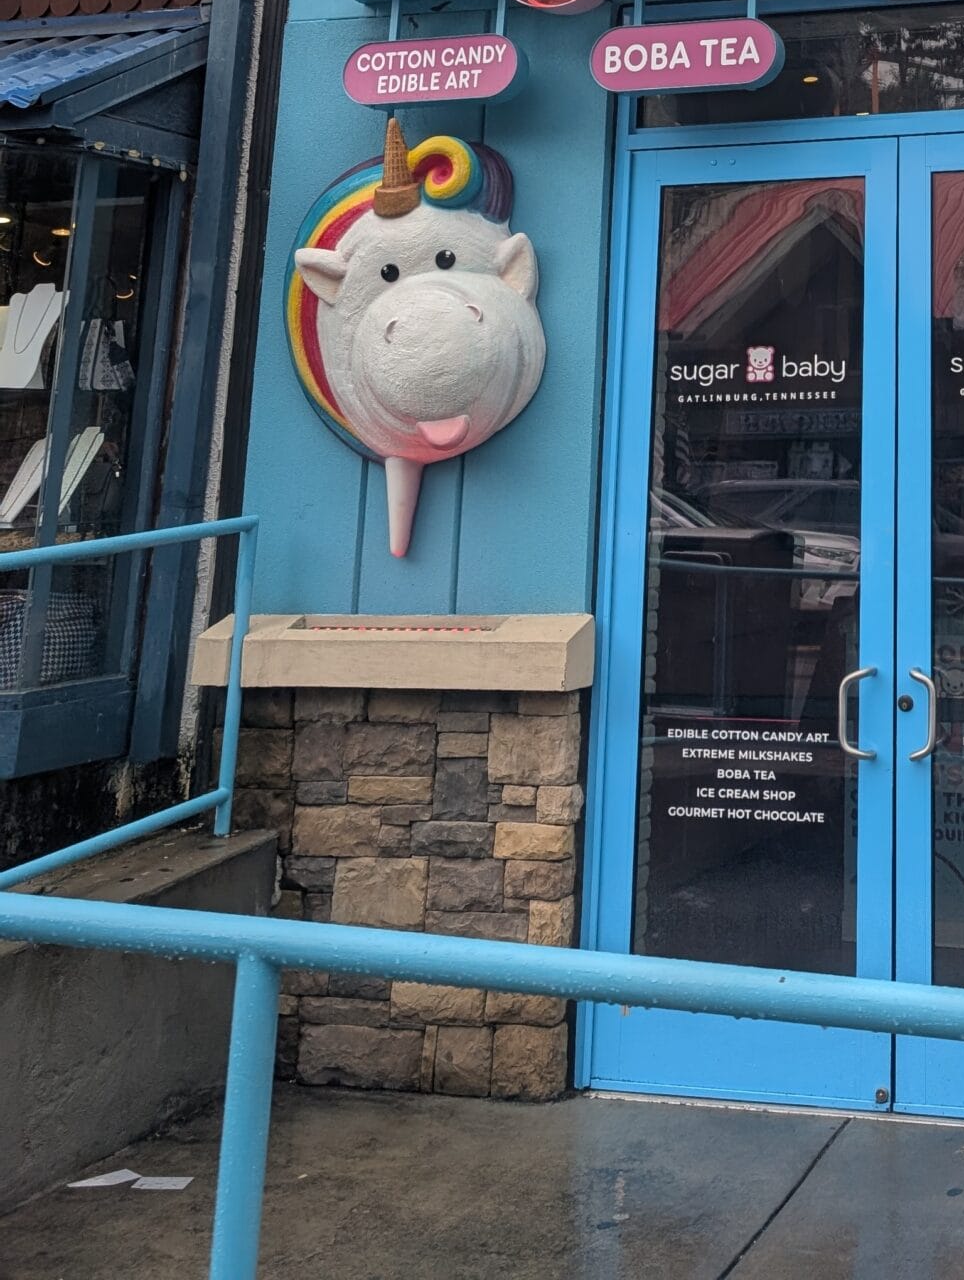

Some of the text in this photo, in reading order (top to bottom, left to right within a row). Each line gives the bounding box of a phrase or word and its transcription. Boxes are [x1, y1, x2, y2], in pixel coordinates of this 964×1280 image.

[356, 43, 507, 73] COTTON CANDY
[604, 36, 760, 74] BOBA TEA
[377, 69, 483, 94] EDIBLE ART
[670, 353, 846, 387] sugar baby
[667, 729, 830, 743] EDIBLE COTTON CANDY ART
[682, 748, 813, 762] EXTREME MILKSHAKES
[717, 769, 776, 780] BOBA TEA
[696, 787, 796, 801] ICE CREAM SHOP
[668, 806, 825, 823] GOURMET HOT CHOCOLATE
